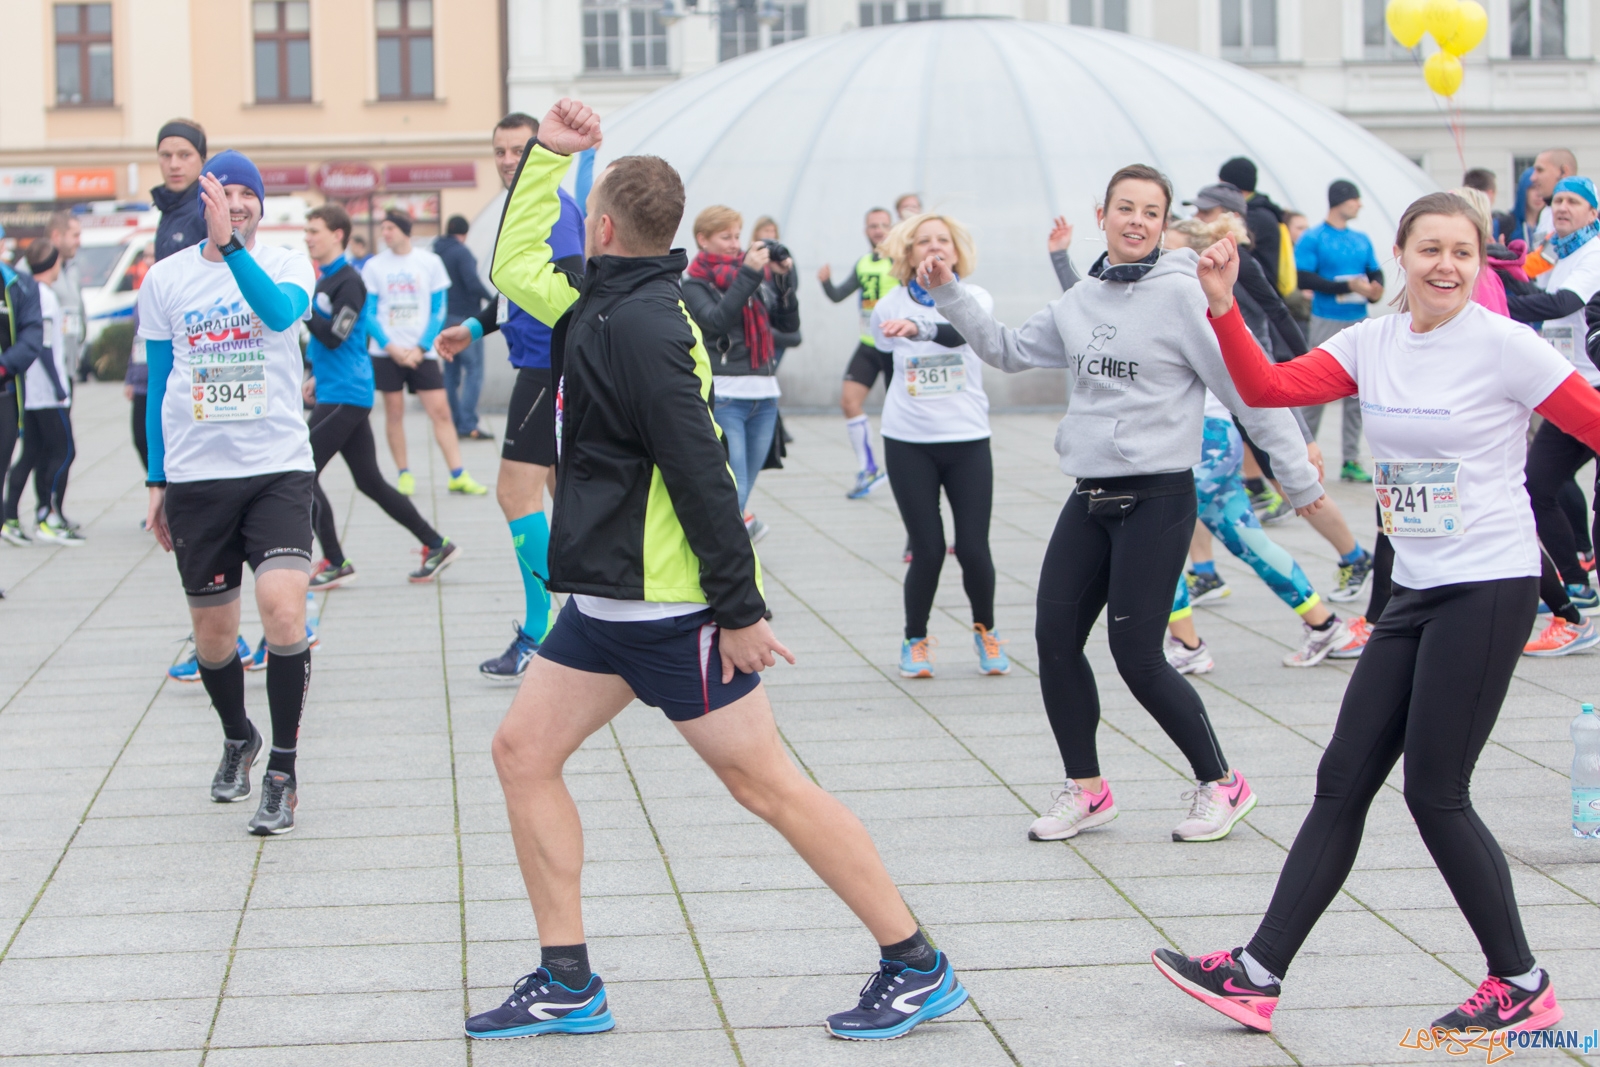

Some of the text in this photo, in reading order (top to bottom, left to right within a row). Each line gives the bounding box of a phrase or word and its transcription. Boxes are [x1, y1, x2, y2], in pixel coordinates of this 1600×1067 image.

[184, 297, 243, 325] PÓŁ
[189, 349, 265, 365] 23.10.2016
[918, 368, 947, 384] 361
[1087, 357, 1139, 381] CHIEF
[206, 383, 247, 403] 394
[1386, 406, 1411, 414] SAMSUNG
[1411, 407, 1451, 415] PÓŁMARATON
[1391, 486, 1428, 512] 241
[1403, 516, 1422, 524] Monika
